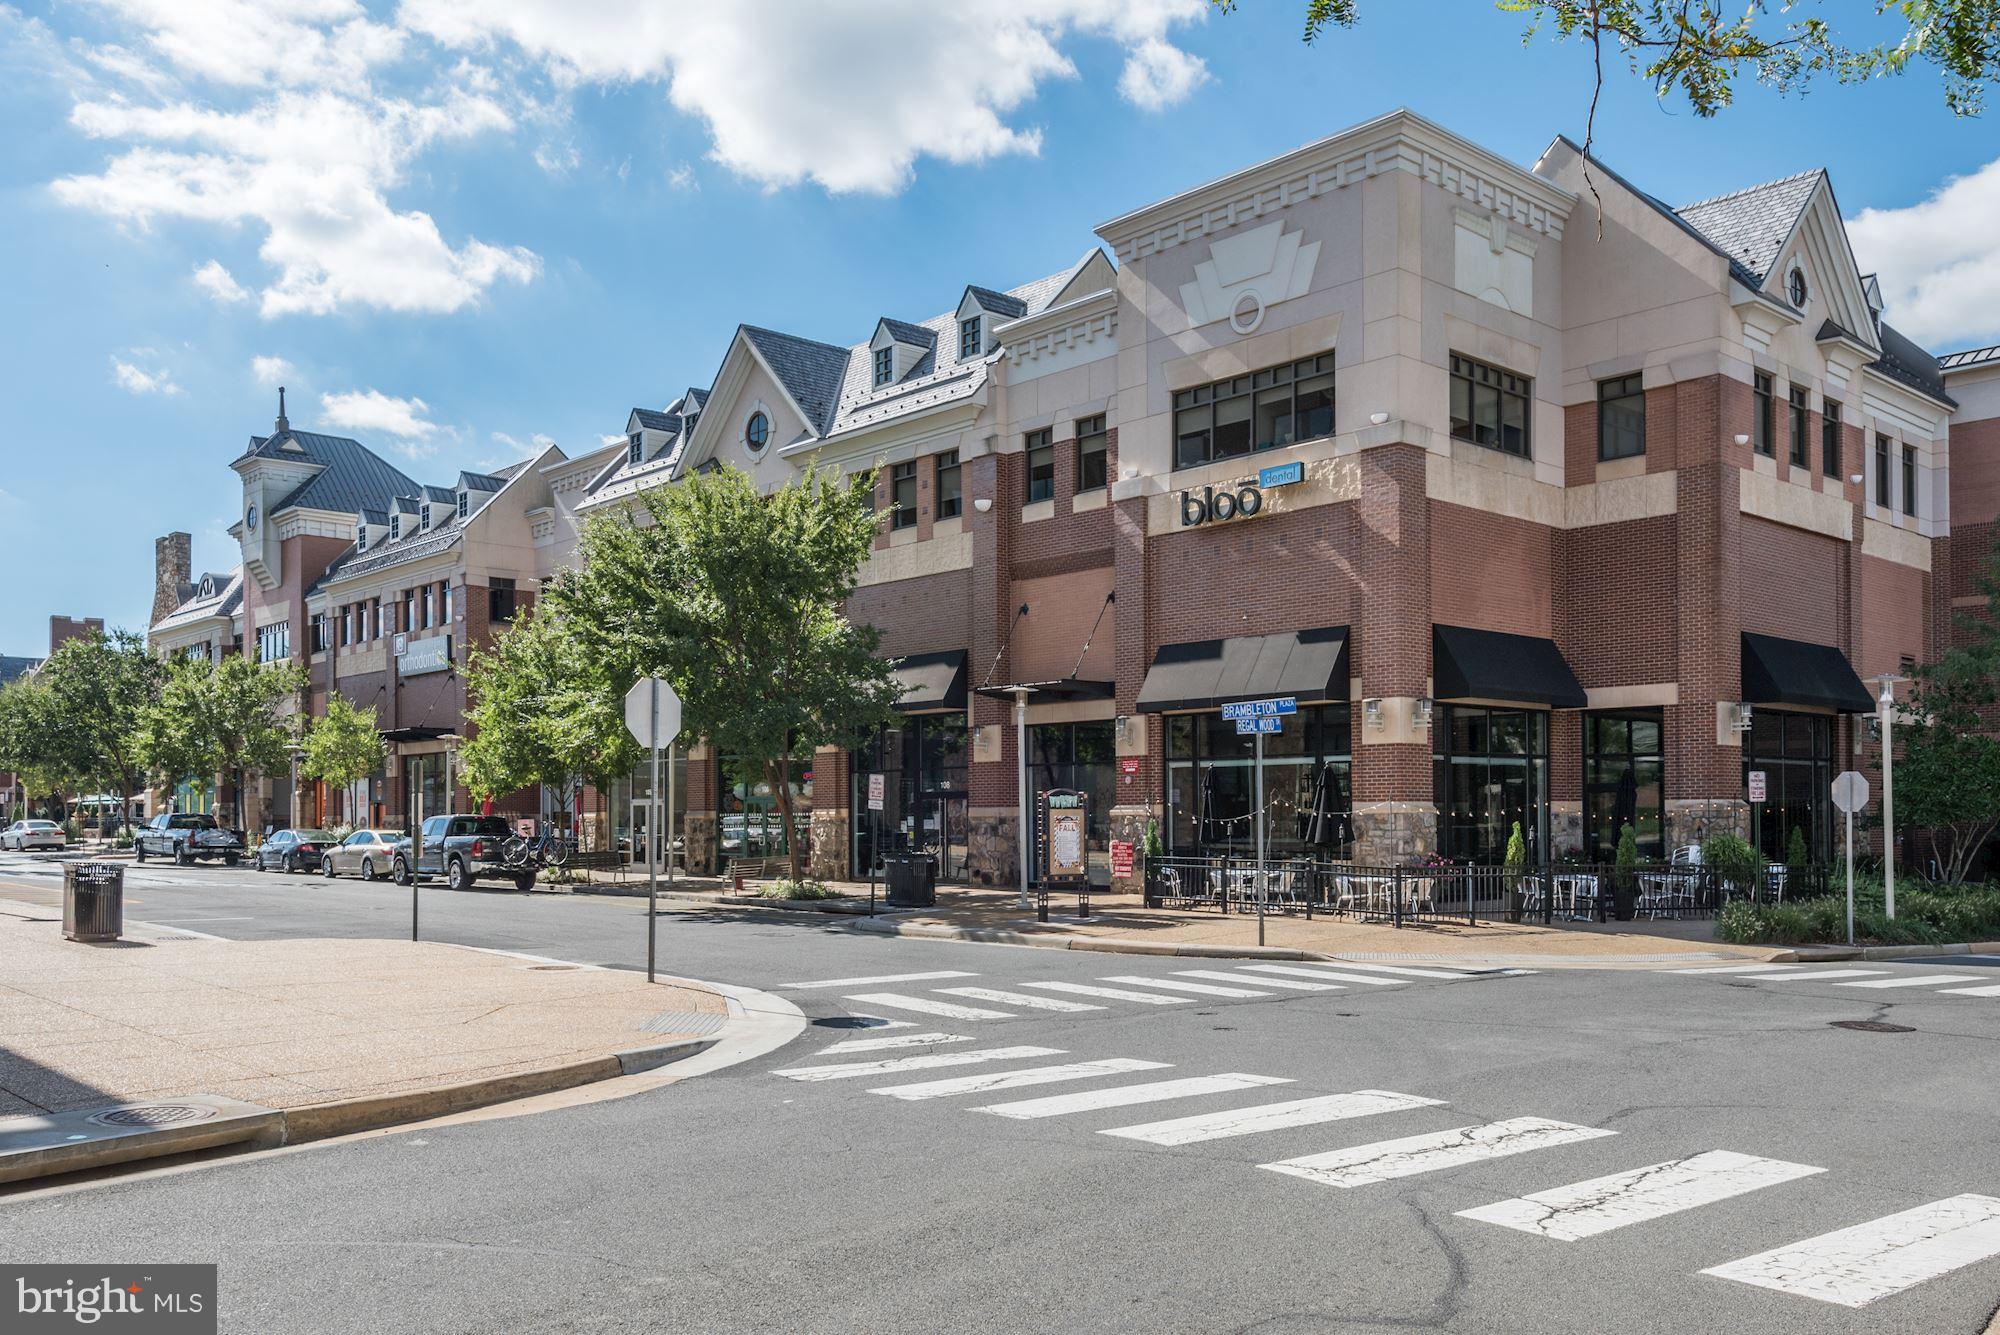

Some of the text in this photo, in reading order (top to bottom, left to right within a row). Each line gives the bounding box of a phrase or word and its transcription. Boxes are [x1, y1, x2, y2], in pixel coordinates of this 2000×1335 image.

[1265, 466, 1296, 484] dental
[1223, 699, 1295, 718] BRAMBLETON PLAZA
[1237, 719, 1258, 731] REGAL
[1259, 718, 1275, 731] WOOD
[1058, 824, 1076, 832] FALL
